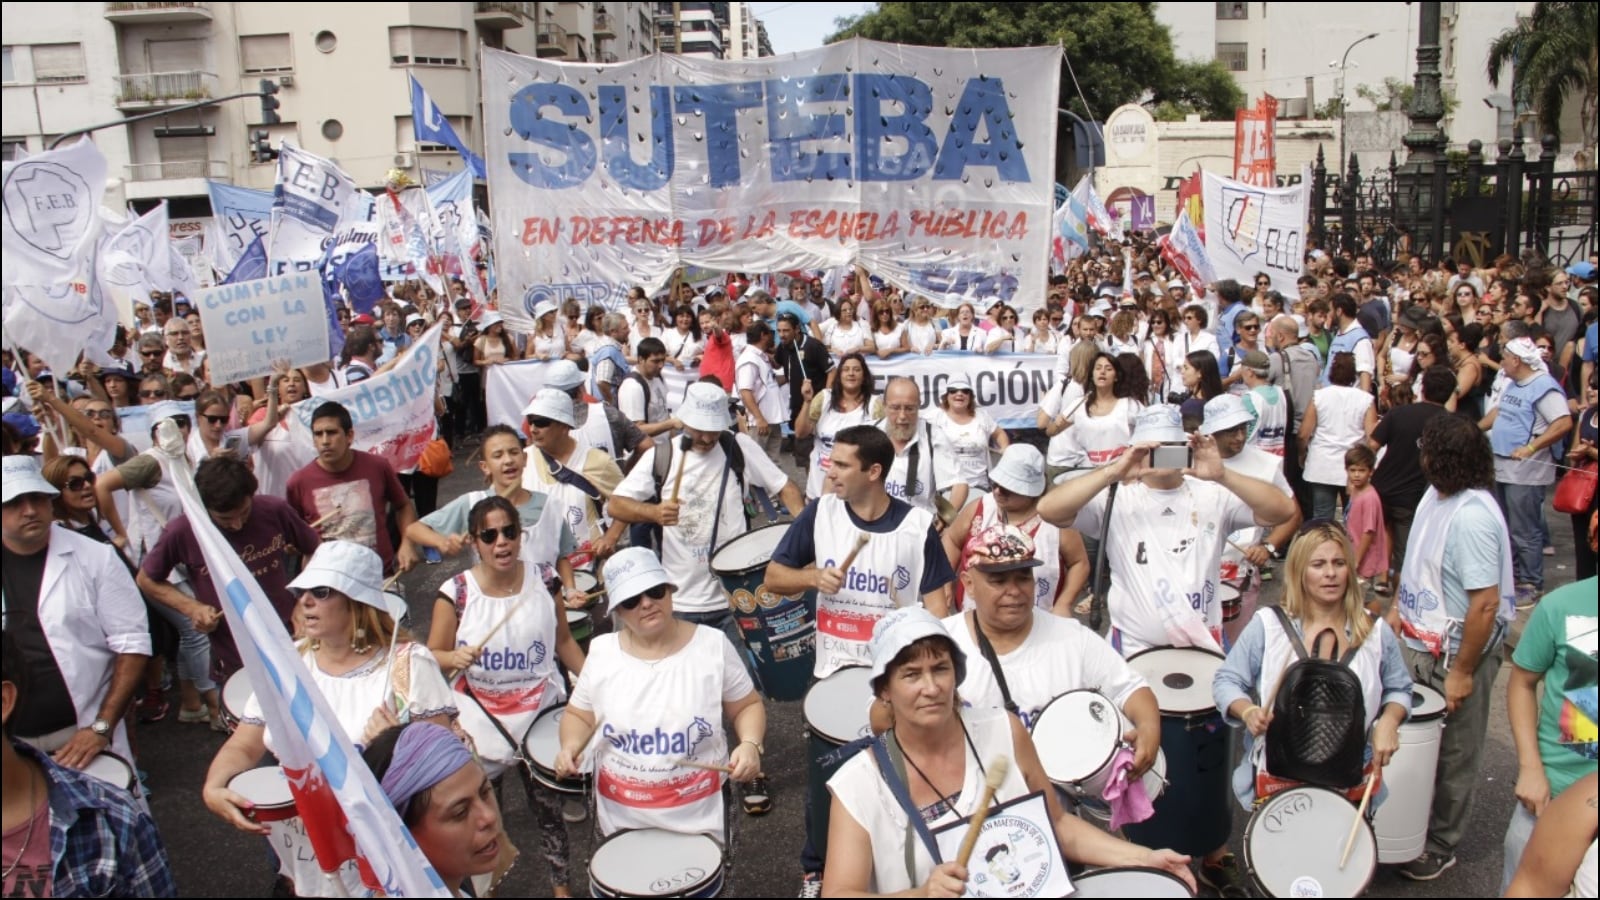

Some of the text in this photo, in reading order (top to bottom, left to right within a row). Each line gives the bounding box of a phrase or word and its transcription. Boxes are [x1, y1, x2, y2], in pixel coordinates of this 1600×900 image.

[507, 73, 1031, 191] SUTEBA
[33, 193, 78, 211] F.E.B.
[521, 216, 560, 245] EN
[569, 216, 683, 246] DEFENSA
[697, 217, 736, 247] DE
[742, 210, 776, 240] LA
[788, 208, 902, 245] ESCUELA
[204, 276, 308, 309] CUMPLAN
[225, 299, 306, 327] CON LA
[251, 327, 288, 345] LEY
[602, 723, 685, 755] Suteba
[993, 819, 1030, 832] MAESTROS
[1268, 799, 1307, 827] VSG
